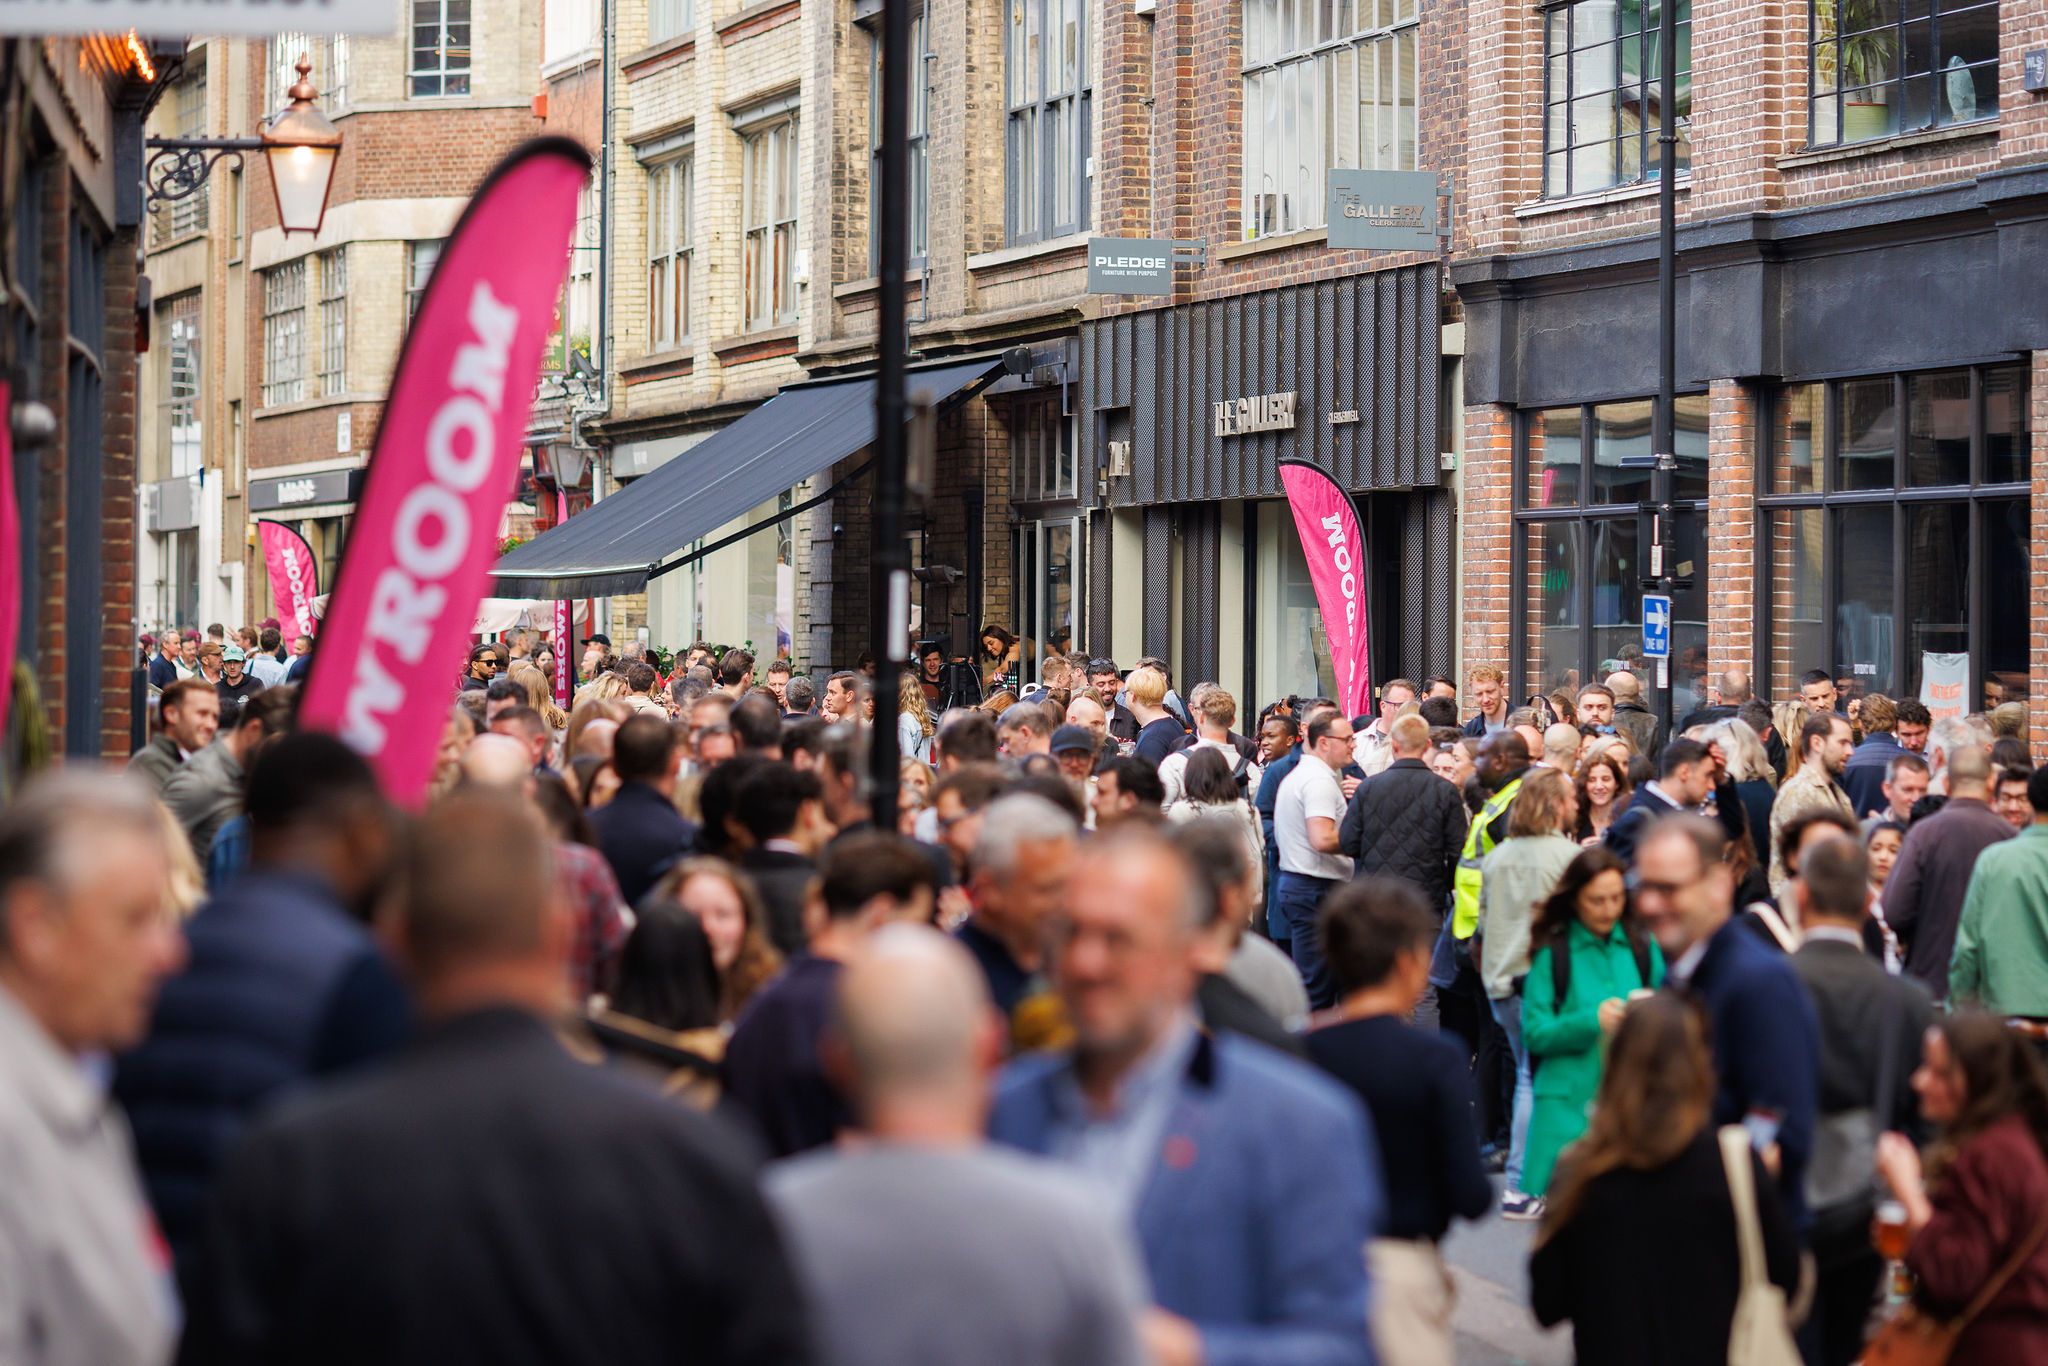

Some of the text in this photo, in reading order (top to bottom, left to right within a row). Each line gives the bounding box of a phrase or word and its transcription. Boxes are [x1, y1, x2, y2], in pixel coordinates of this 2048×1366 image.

[1338, 194, 1360, 204] THE
[1343, 204, 1425, 219] GALLERY
[1095, 256, 1166, 269] PLEDGE
[537, 360, 561, 370] RMS
[1236, 391, 1298, 434] GALLERY
[282, 547, 315, 640] OWROOM
